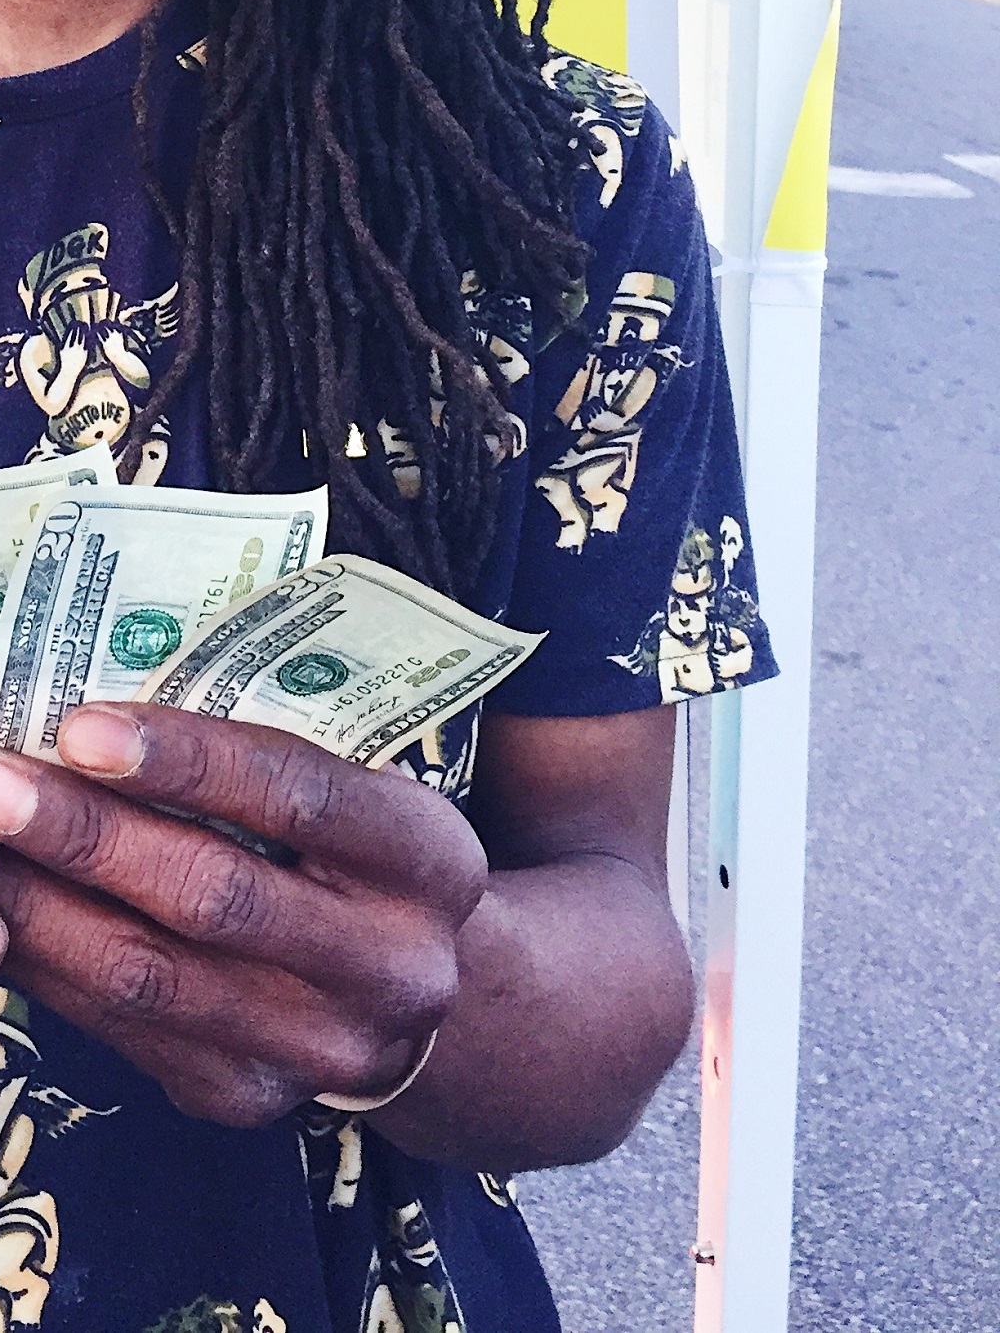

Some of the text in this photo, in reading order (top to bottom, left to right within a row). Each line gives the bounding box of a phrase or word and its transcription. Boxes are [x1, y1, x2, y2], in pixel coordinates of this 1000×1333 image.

[34, 500, 83, 566] 20
[274, 559, 346, 603] 20
[16, 596, 40, 650] NOTE
[37, 530, 105, 749] UNITED STATES
[48, 622, 63, 655] THE
[67, 550, 120, 687] AMERICA
[229, 636, 254, 662] THE
[232, 609, 347, 692] AMERICA
[251, 589, 344, 657] STATES
[388, 647, 515, 737] DOLLARS
[403, 644, 472, 691] 20
